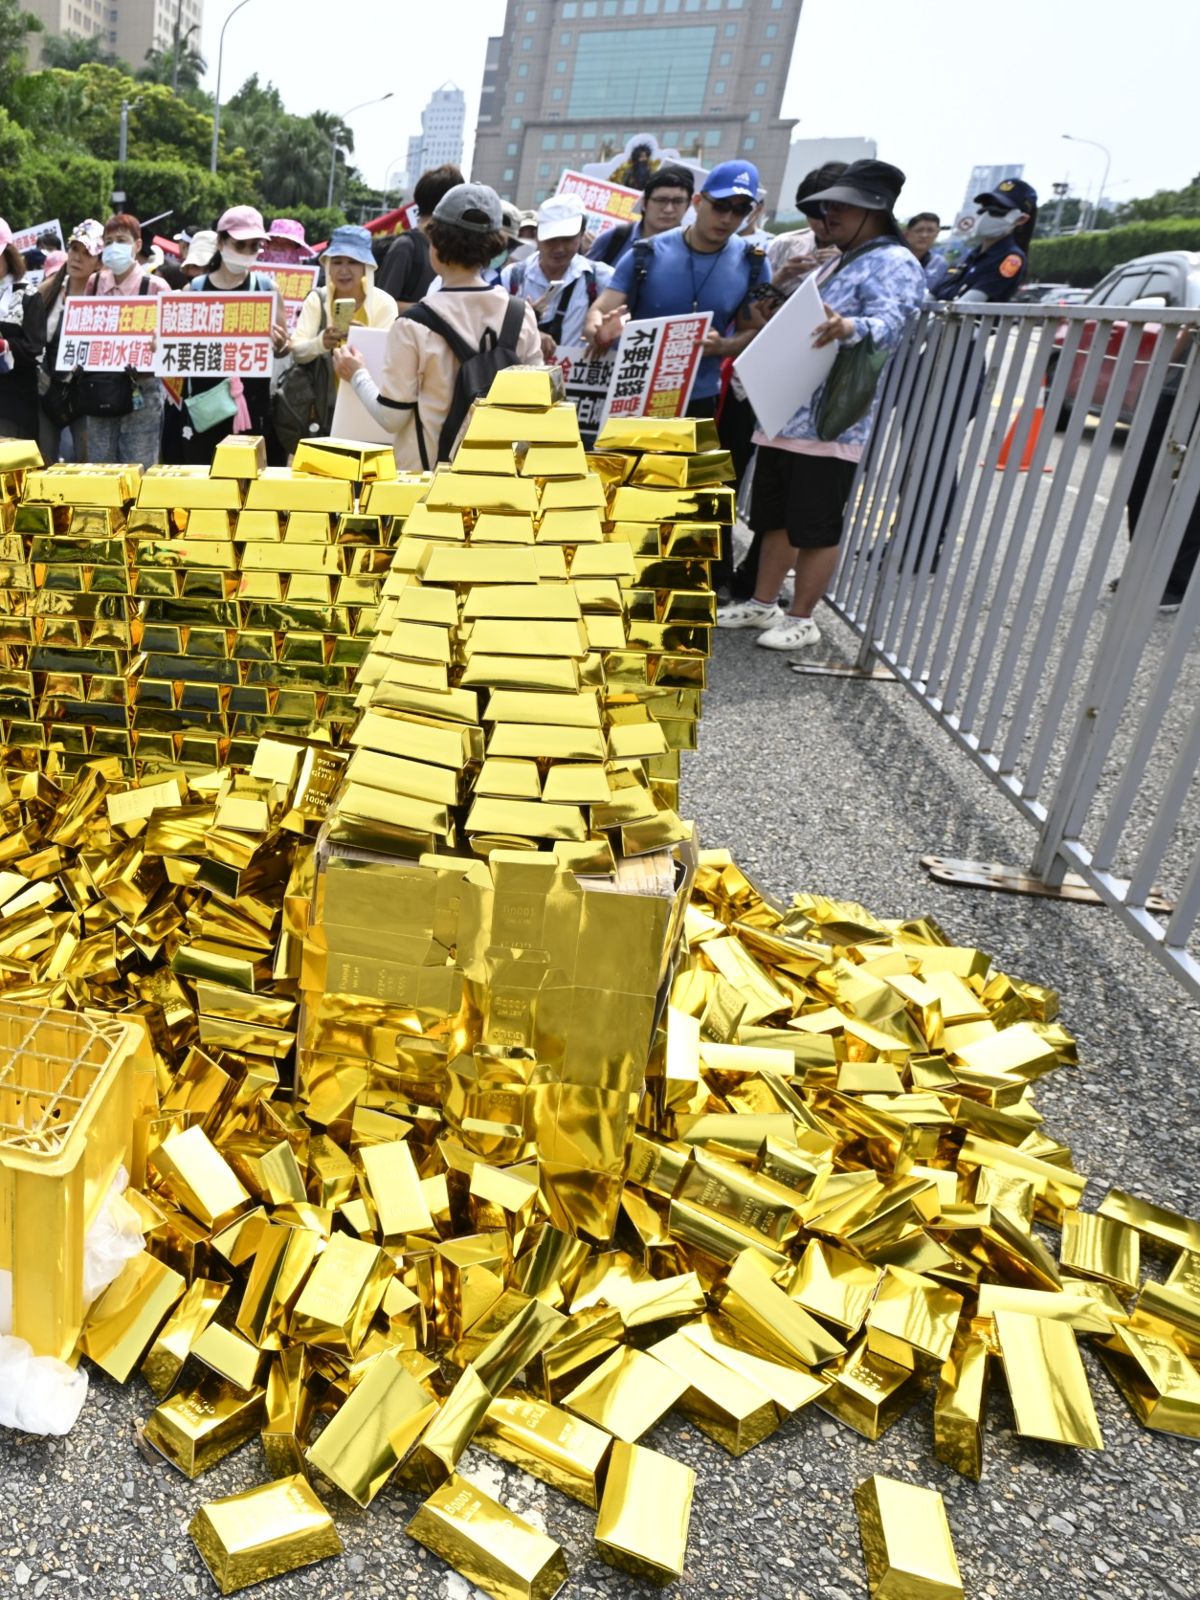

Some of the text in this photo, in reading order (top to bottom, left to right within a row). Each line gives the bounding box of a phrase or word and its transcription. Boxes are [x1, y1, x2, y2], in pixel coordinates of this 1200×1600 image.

[162, 301, 271, 333] 敲醒政府睜開眼
[63, 339, 154, 366] 為何圖利水貨商
[162, 342, 269, 372] 不要有錢當乞丐
[609, 327, 658, 416] 不要有錢當
